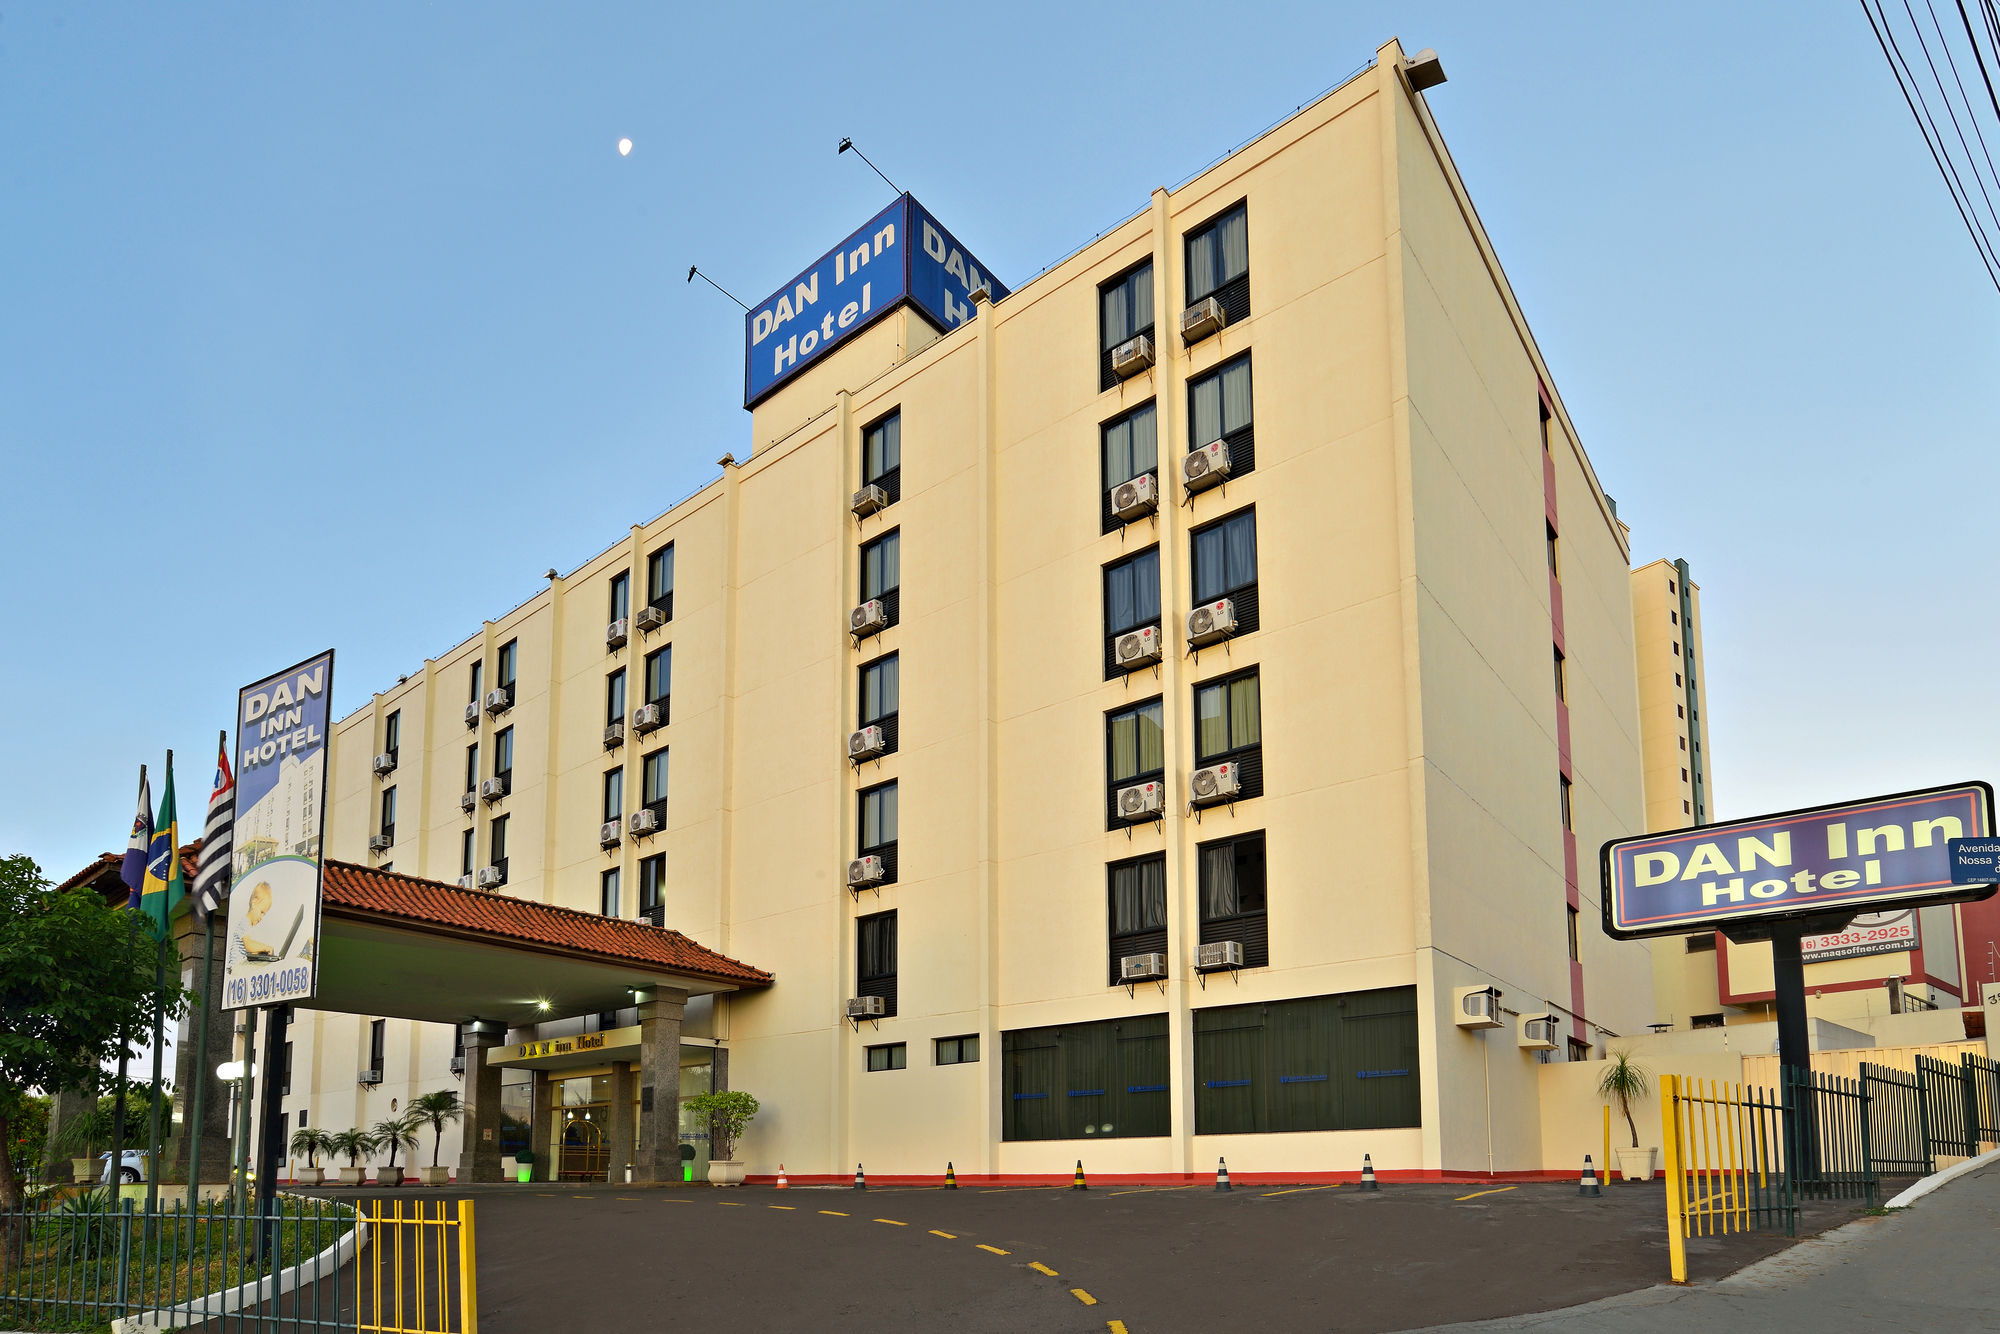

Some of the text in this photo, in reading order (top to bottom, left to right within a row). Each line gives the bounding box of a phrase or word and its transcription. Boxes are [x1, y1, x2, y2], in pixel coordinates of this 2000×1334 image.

[922, 219, 992, 302] DAN
[752, 223, 895, 346] DAN Inn
[774, 281, 871, 376] Hotel
[245, 665, 324, 723] DAN
[260, 705, 302, 739] INN
[243, 724, 321, 768] HOTEL
[1633, 814, 1964, 888] DAN Inn
[1958, 843, 2000, 853] Avenida
[1958, 856, 1992, 865] Nossa
[1701, 859, 1882, 906] Hotel
[1820, 925, 1910, 947] 3333-2925
[227, 966, 308, 1008] (16) 3301-0058
[576, 1033, 605, 1049] Hotel
